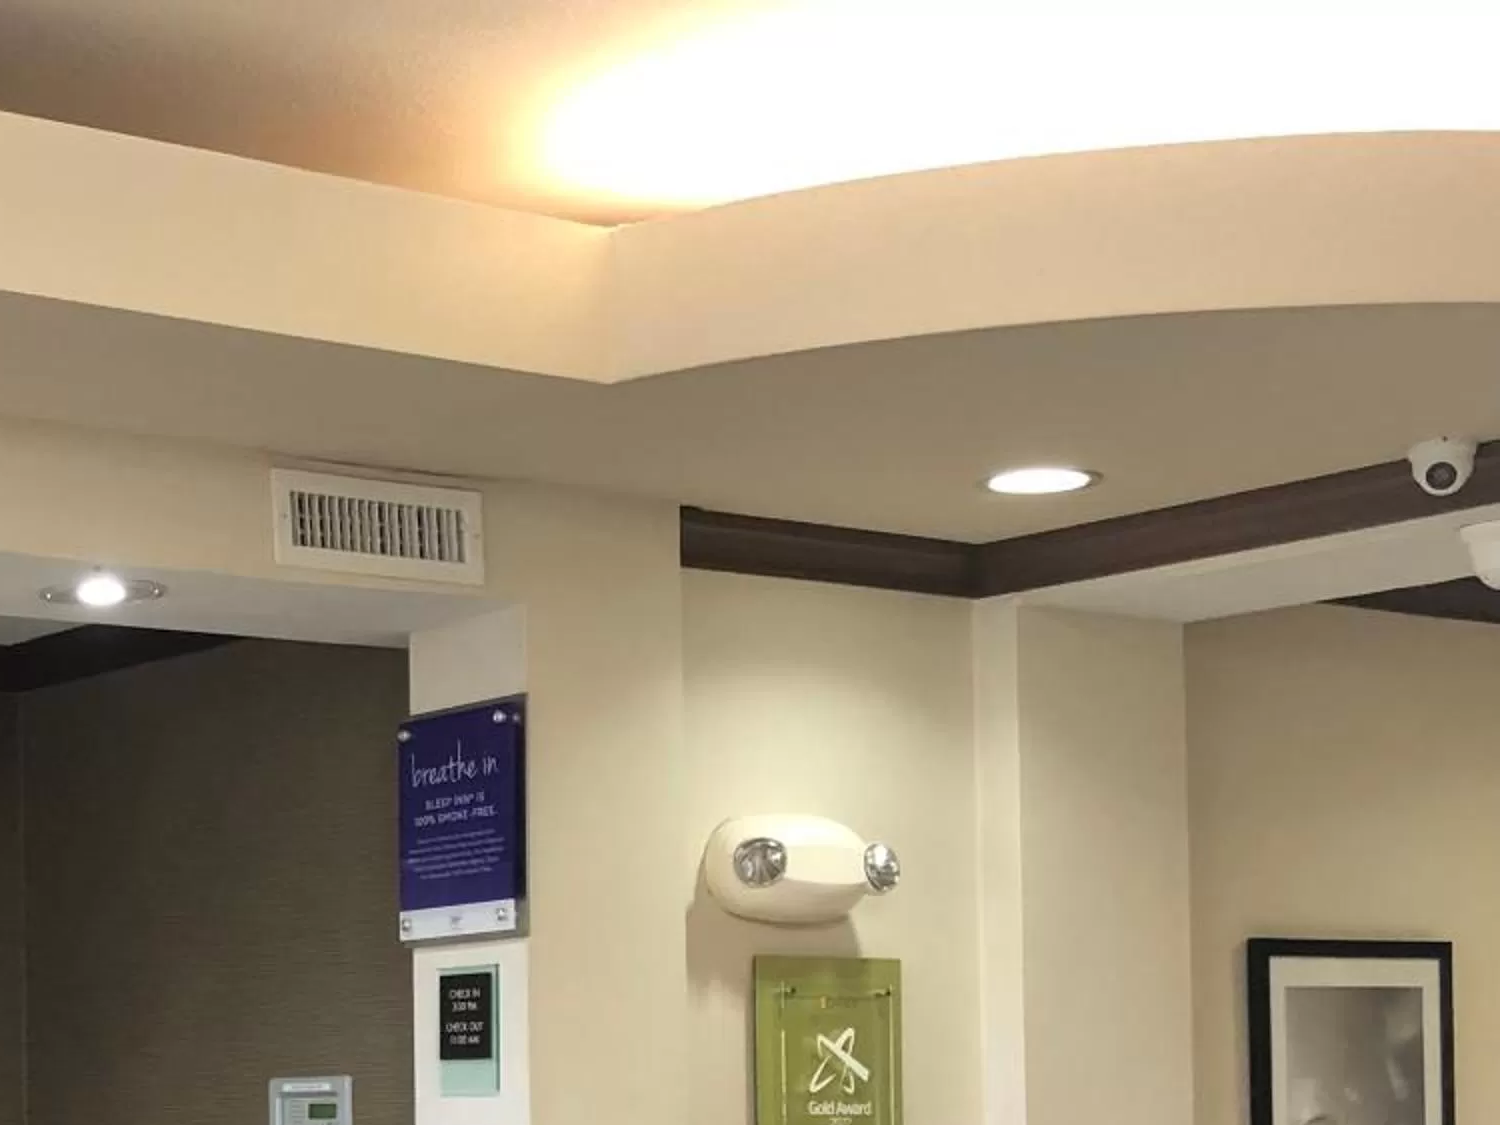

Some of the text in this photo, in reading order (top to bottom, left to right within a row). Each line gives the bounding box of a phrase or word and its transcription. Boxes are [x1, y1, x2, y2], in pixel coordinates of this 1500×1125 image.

[411, 738, 500, 788] breathe in
[425, 797, 452, 811] SLEEP
[413, 815, 436, 827] 100%
[437, 809, 468, 824] SMOKE
[448, 986, 481, 1000] CHECK IN
[467, 1001, 478, 1011] PM
[445, 1021, 484, 1033] CHECK OUT
[808, 1100, 872, 1116] Gold Award
